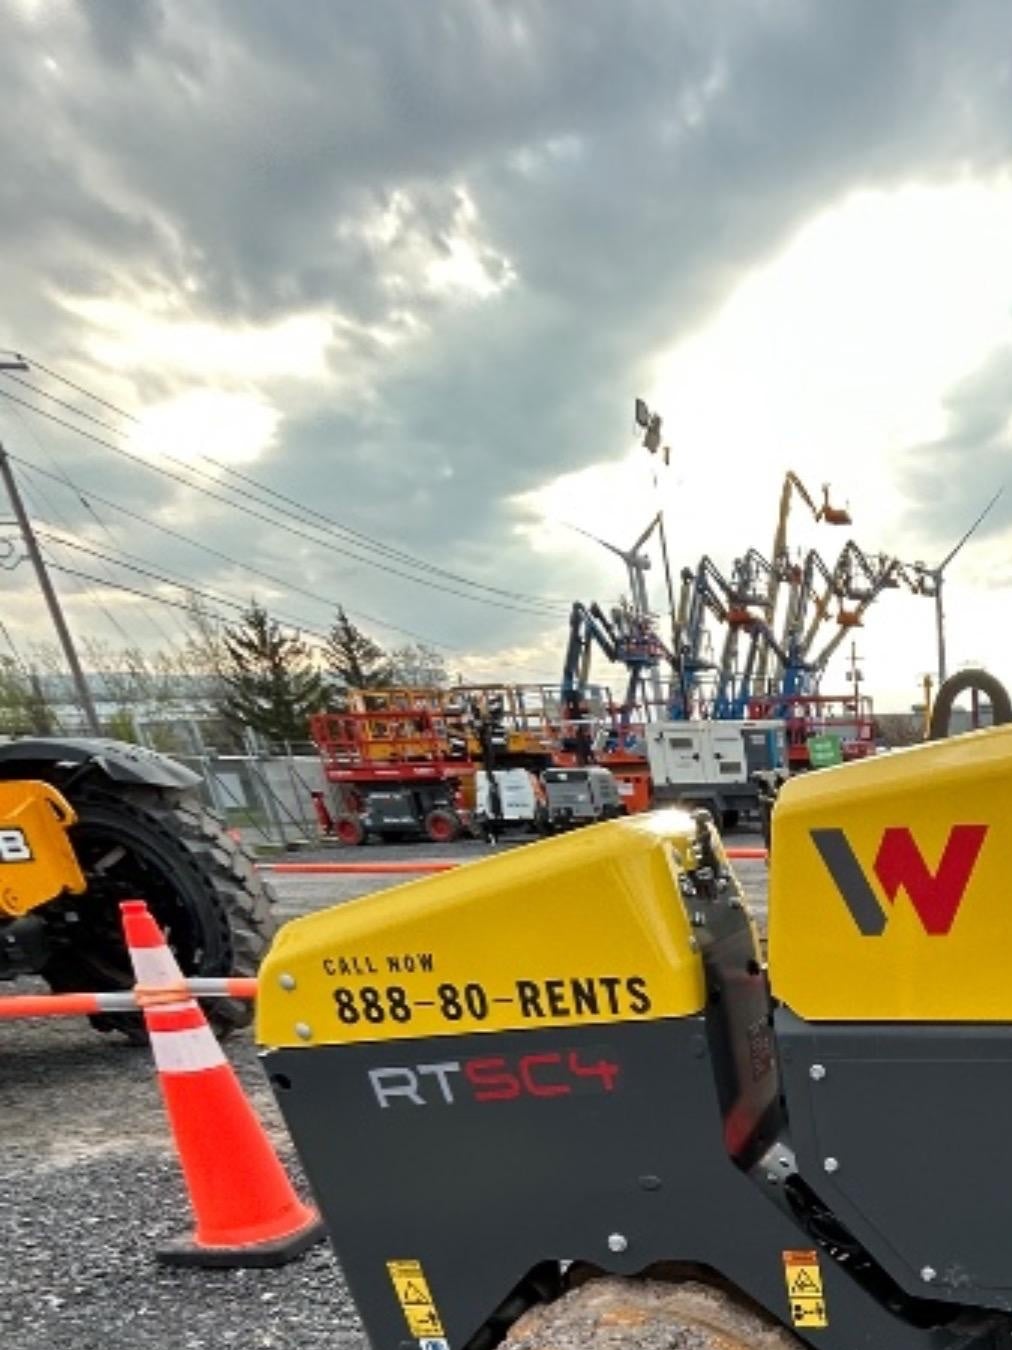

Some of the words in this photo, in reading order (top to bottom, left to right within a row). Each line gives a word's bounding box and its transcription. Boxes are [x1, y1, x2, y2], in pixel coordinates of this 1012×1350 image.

[322, 956, 379, 976] CALL
[387, 953, 435, 973] NOW
[333, 976, 652, 1024] 888-80-RENTS
